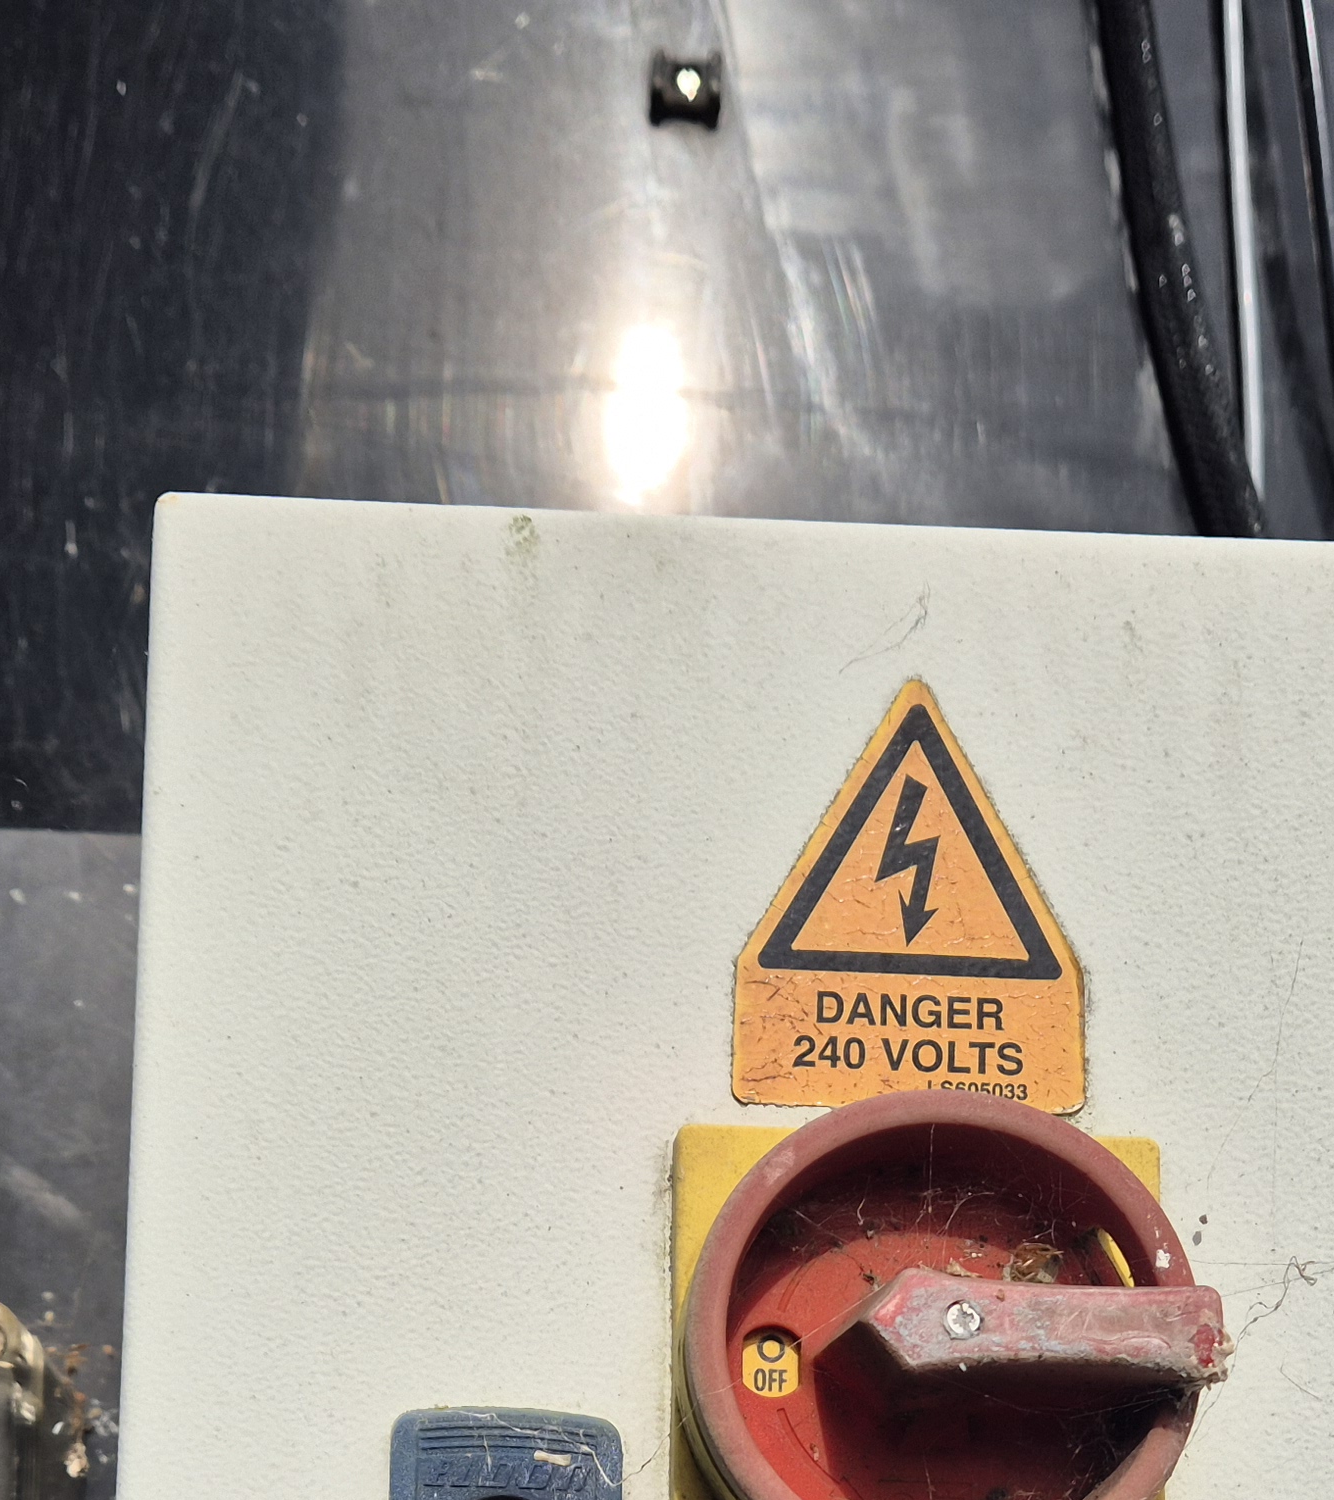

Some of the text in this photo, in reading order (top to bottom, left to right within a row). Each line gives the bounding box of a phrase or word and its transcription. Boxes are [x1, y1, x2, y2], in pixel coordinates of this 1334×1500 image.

[815, 990, 1005, 1032] DANGER
[792, 1034, 1024, 1077] 240 VOLTS
[753, 1367, 789, 1393] OFF
